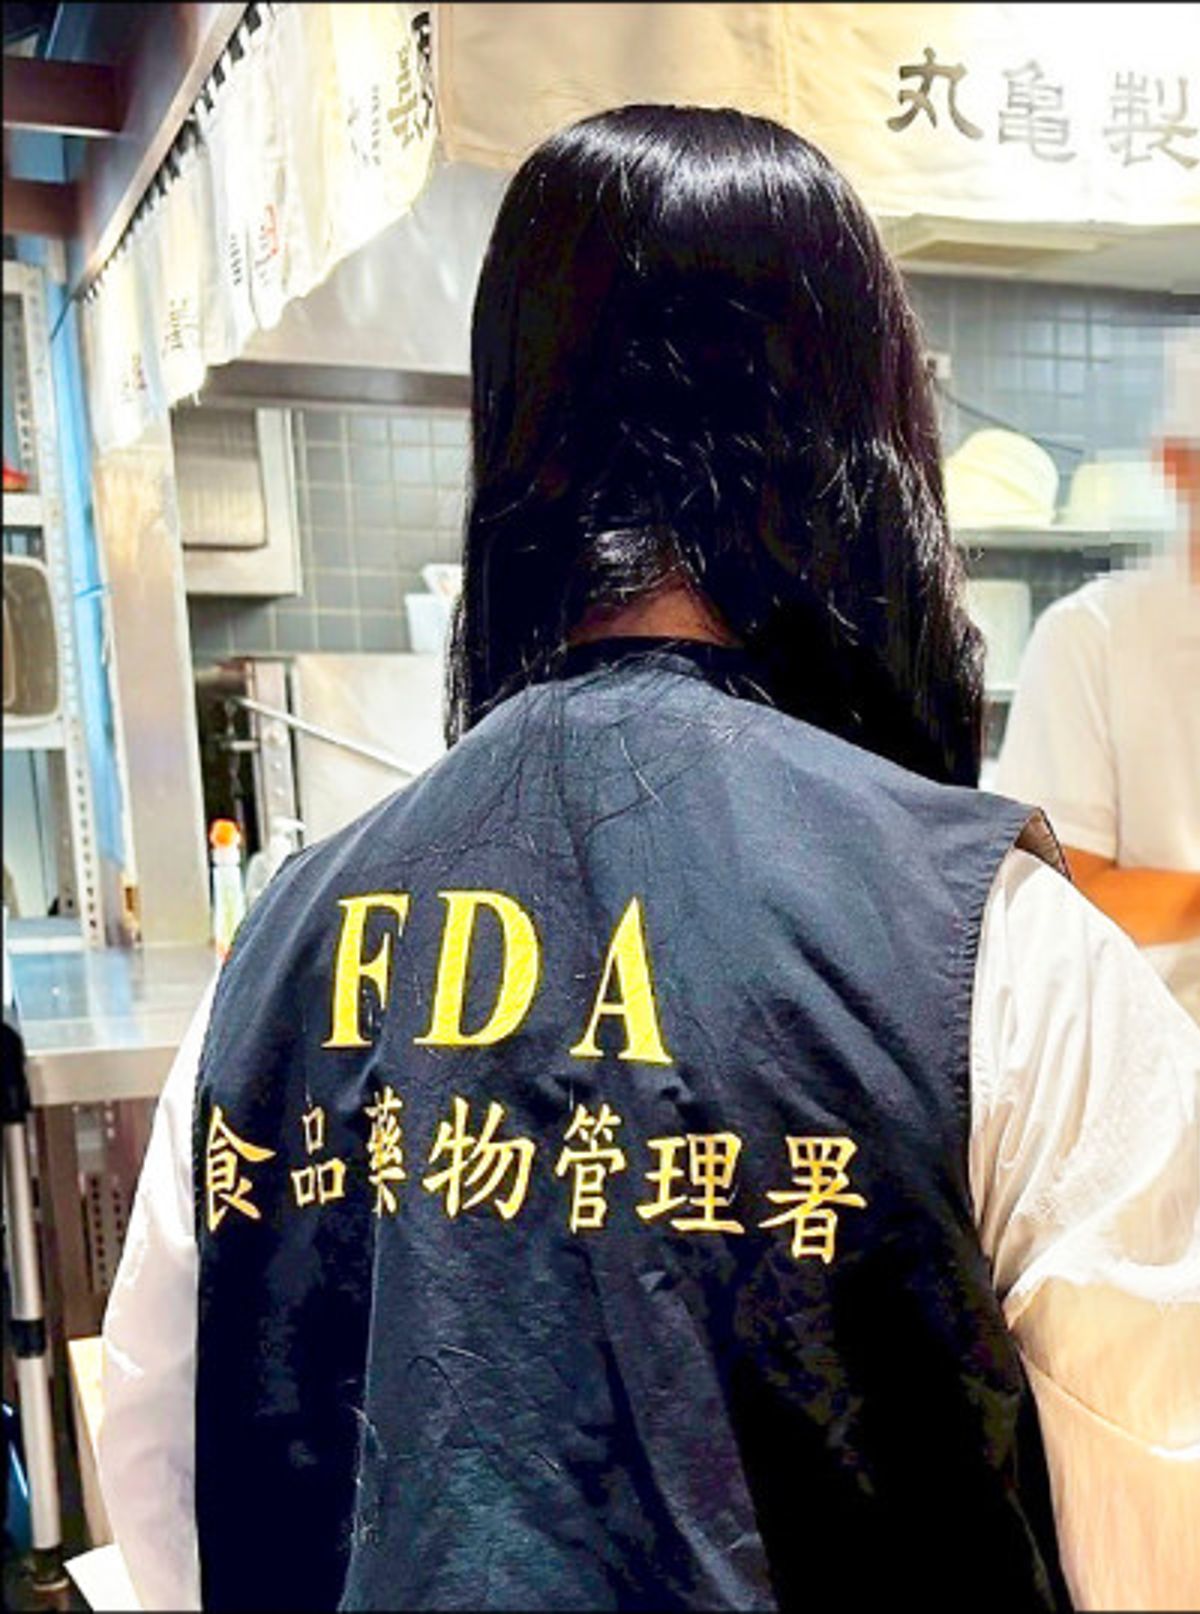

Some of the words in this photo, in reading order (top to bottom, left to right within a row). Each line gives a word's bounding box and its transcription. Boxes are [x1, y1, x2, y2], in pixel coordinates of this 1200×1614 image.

[321, 889, 674, 1066] FDA
[205, 1085, 868, 1265] 食品藥物管理署
